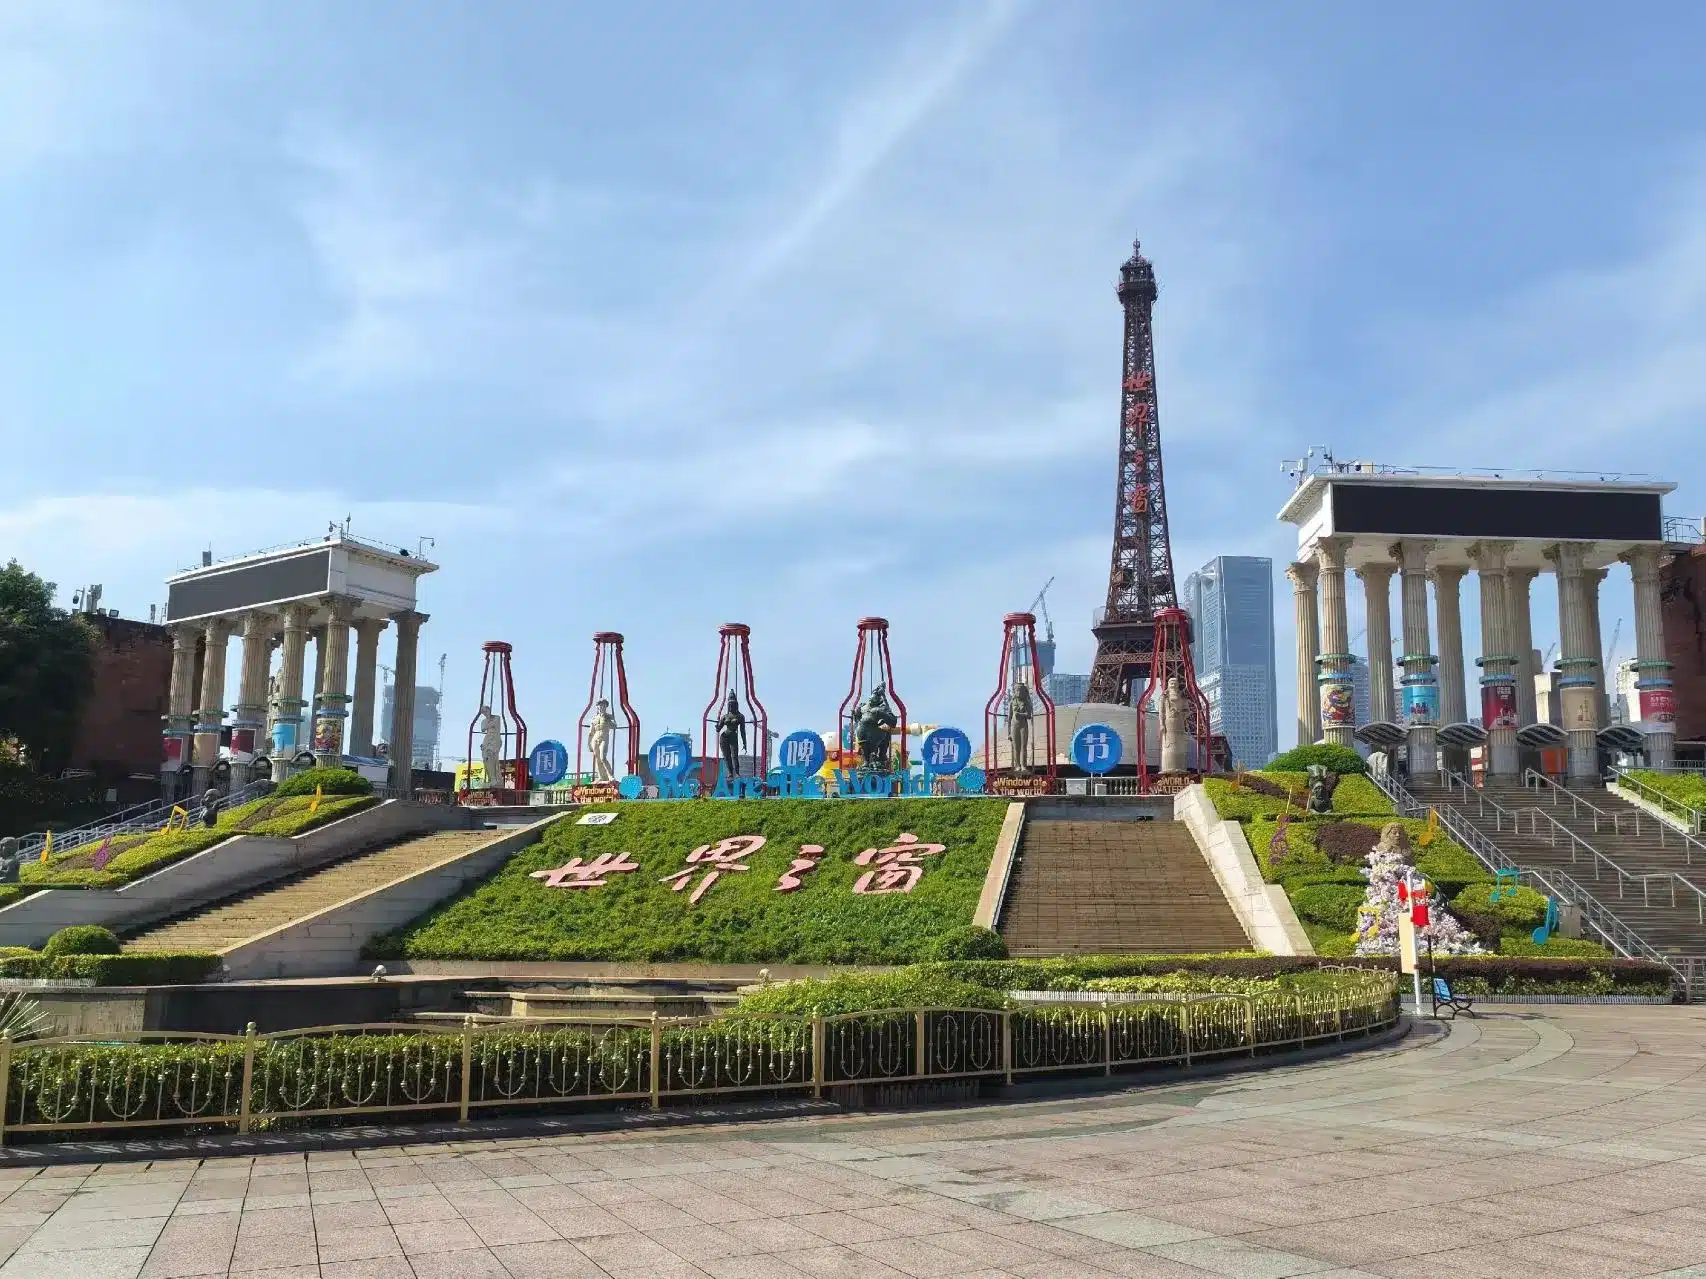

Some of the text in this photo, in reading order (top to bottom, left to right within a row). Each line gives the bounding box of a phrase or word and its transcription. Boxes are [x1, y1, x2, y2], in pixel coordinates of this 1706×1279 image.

[536, 732, 1112, 776] 国 际 啤 酒 节
[578, 785, 605, 795] Window
[711, 760, 767, 799] Are
[831, 763, 934, 798] World
[997, 777, 1043, 787] Window of
[1000, 787, 1043, 796] the world
[529, 833, 946, 904] 世界之窗
